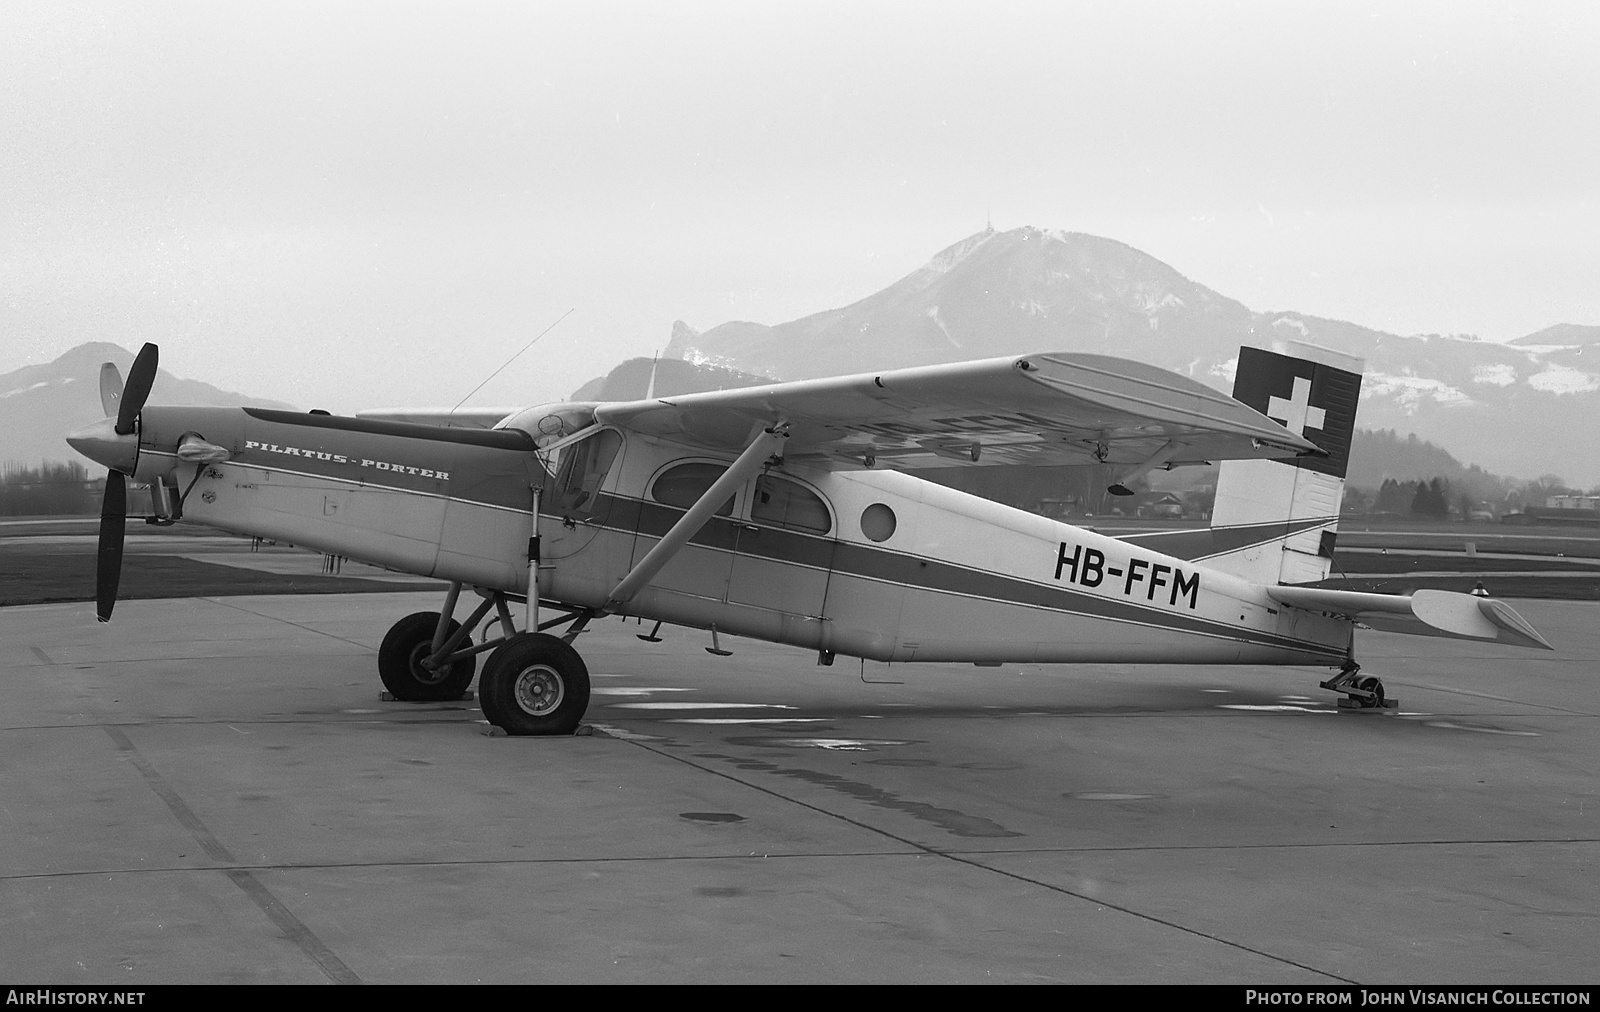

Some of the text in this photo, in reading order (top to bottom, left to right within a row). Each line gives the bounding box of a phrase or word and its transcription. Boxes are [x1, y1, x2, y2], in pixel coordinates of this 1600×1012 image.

[245, 440, 348, 464] PILATUS
[360, 458, 450, 481] PORTER
[1054, 541, 1200, 610] HB-FFM
